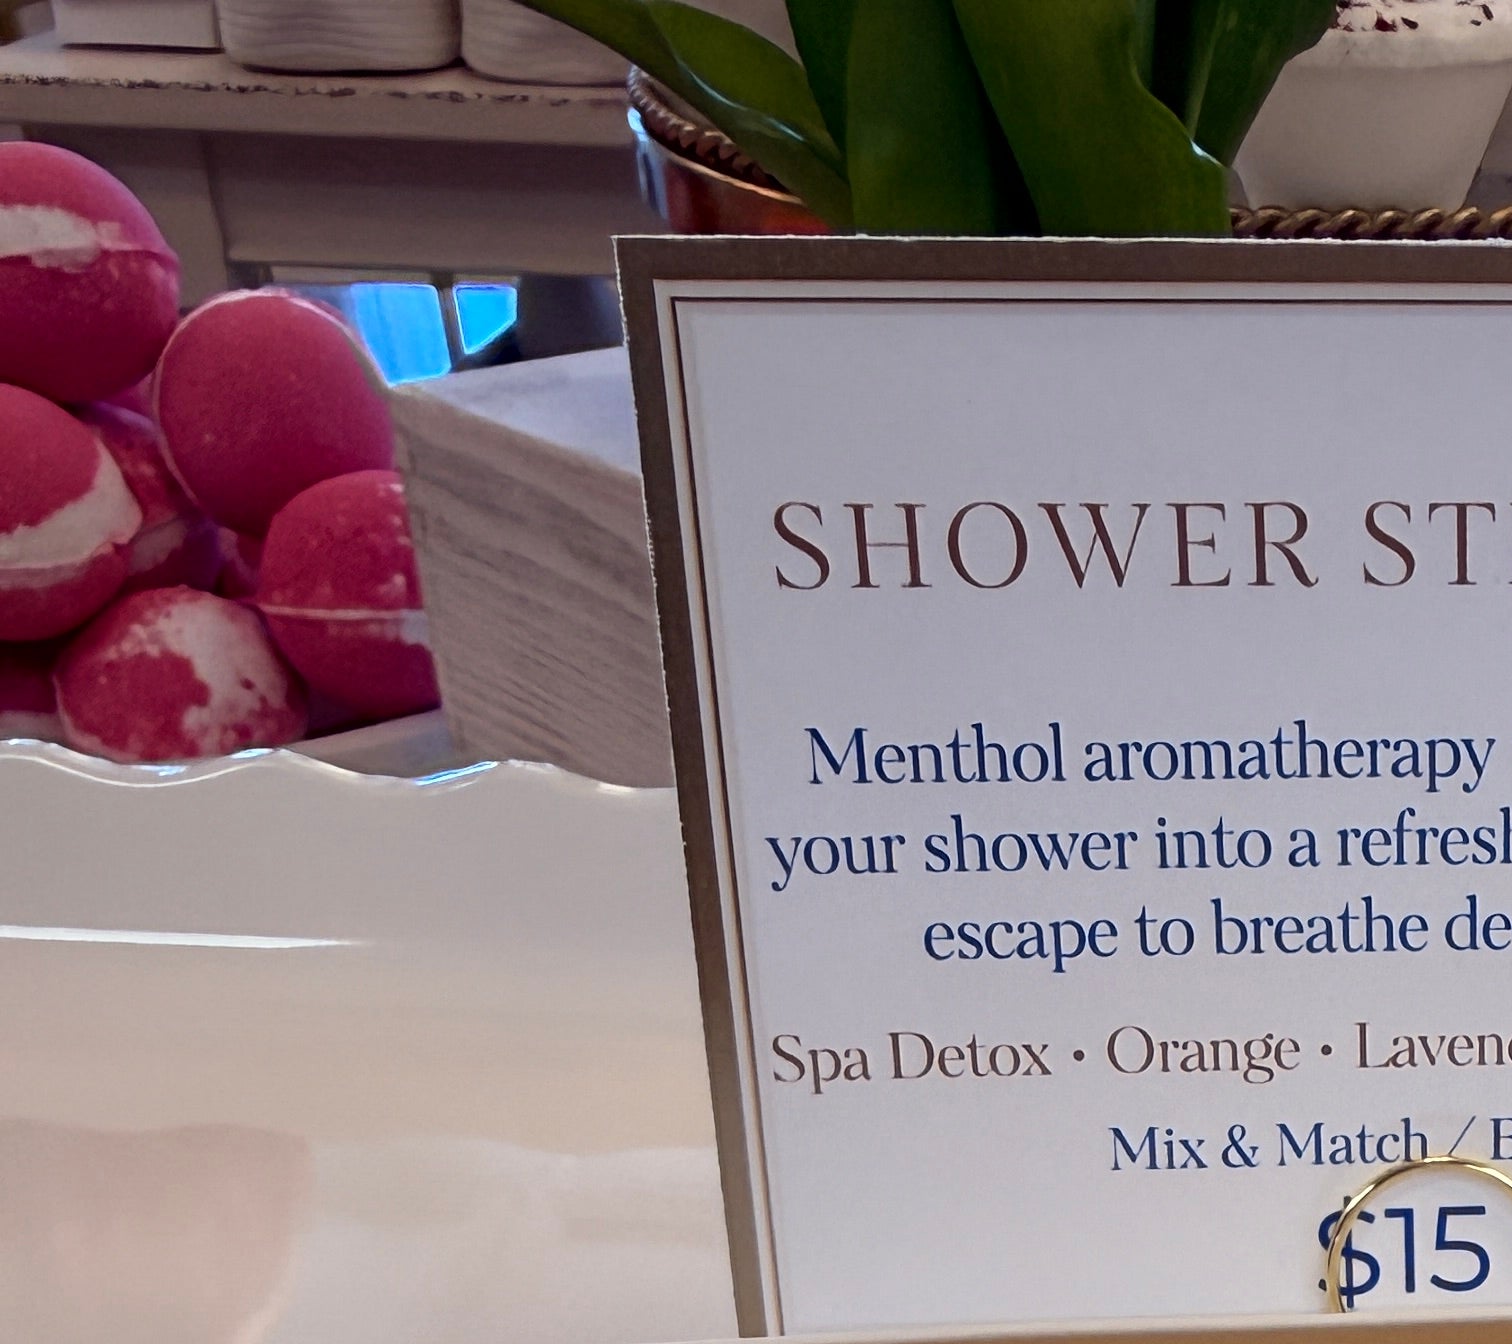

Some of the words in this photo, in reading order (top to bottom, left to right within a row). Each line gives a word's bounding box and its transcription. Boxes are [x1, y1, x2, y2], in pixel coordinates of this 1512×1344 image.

[774, 502, 1319, 590] SHOWER
[804, 722, 1067, 784] Menthol
[1084, 720, 1496, 793] aromatherapy
[765, 835, 905, 892] your
[925, 814, 1138, 873] shower
[1155, 816, 1272, 869] into
[1288, 829, 1320, 867] a
[924, 920, 1118, 973] escape
[1134, 905, 1194, 956] to
[1210, 896, 1428, 955] breathe
[773, 1035, 872, 1094] Spa
[888, 1032, 1052, 1079] Detox
[1107, 1026, 1300, 1084] Orange
[1108, 1127, 1208, 1171] Mix
[1222, 1124, 1259, 1168] &
[1276, 1117, 1430, 1167] Match
[1447, 1115, 1478, 1158] /
[1318, 1195, 1491, 1309] $15
